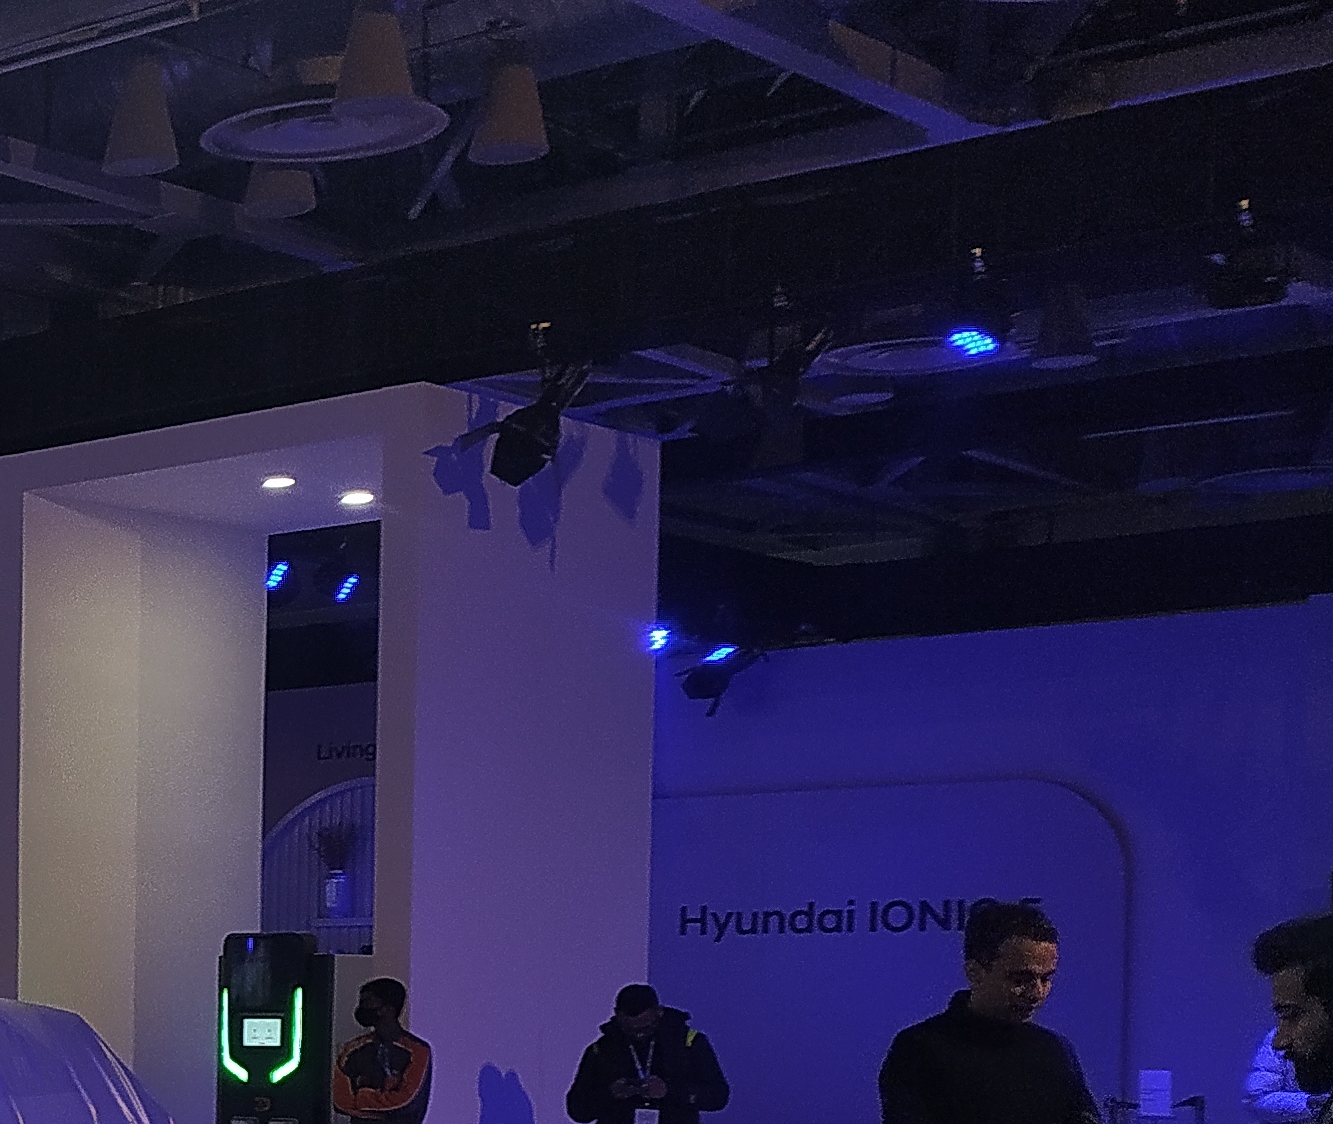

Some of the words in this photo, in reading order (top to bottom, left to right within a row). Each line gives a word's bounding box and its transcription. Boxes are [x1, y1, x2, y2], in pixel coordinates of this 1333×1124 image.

[317, 743, 376, 762] Living
[678, 898, 856, 943] Hyundai
[868, 897, 993, 933] IONI
